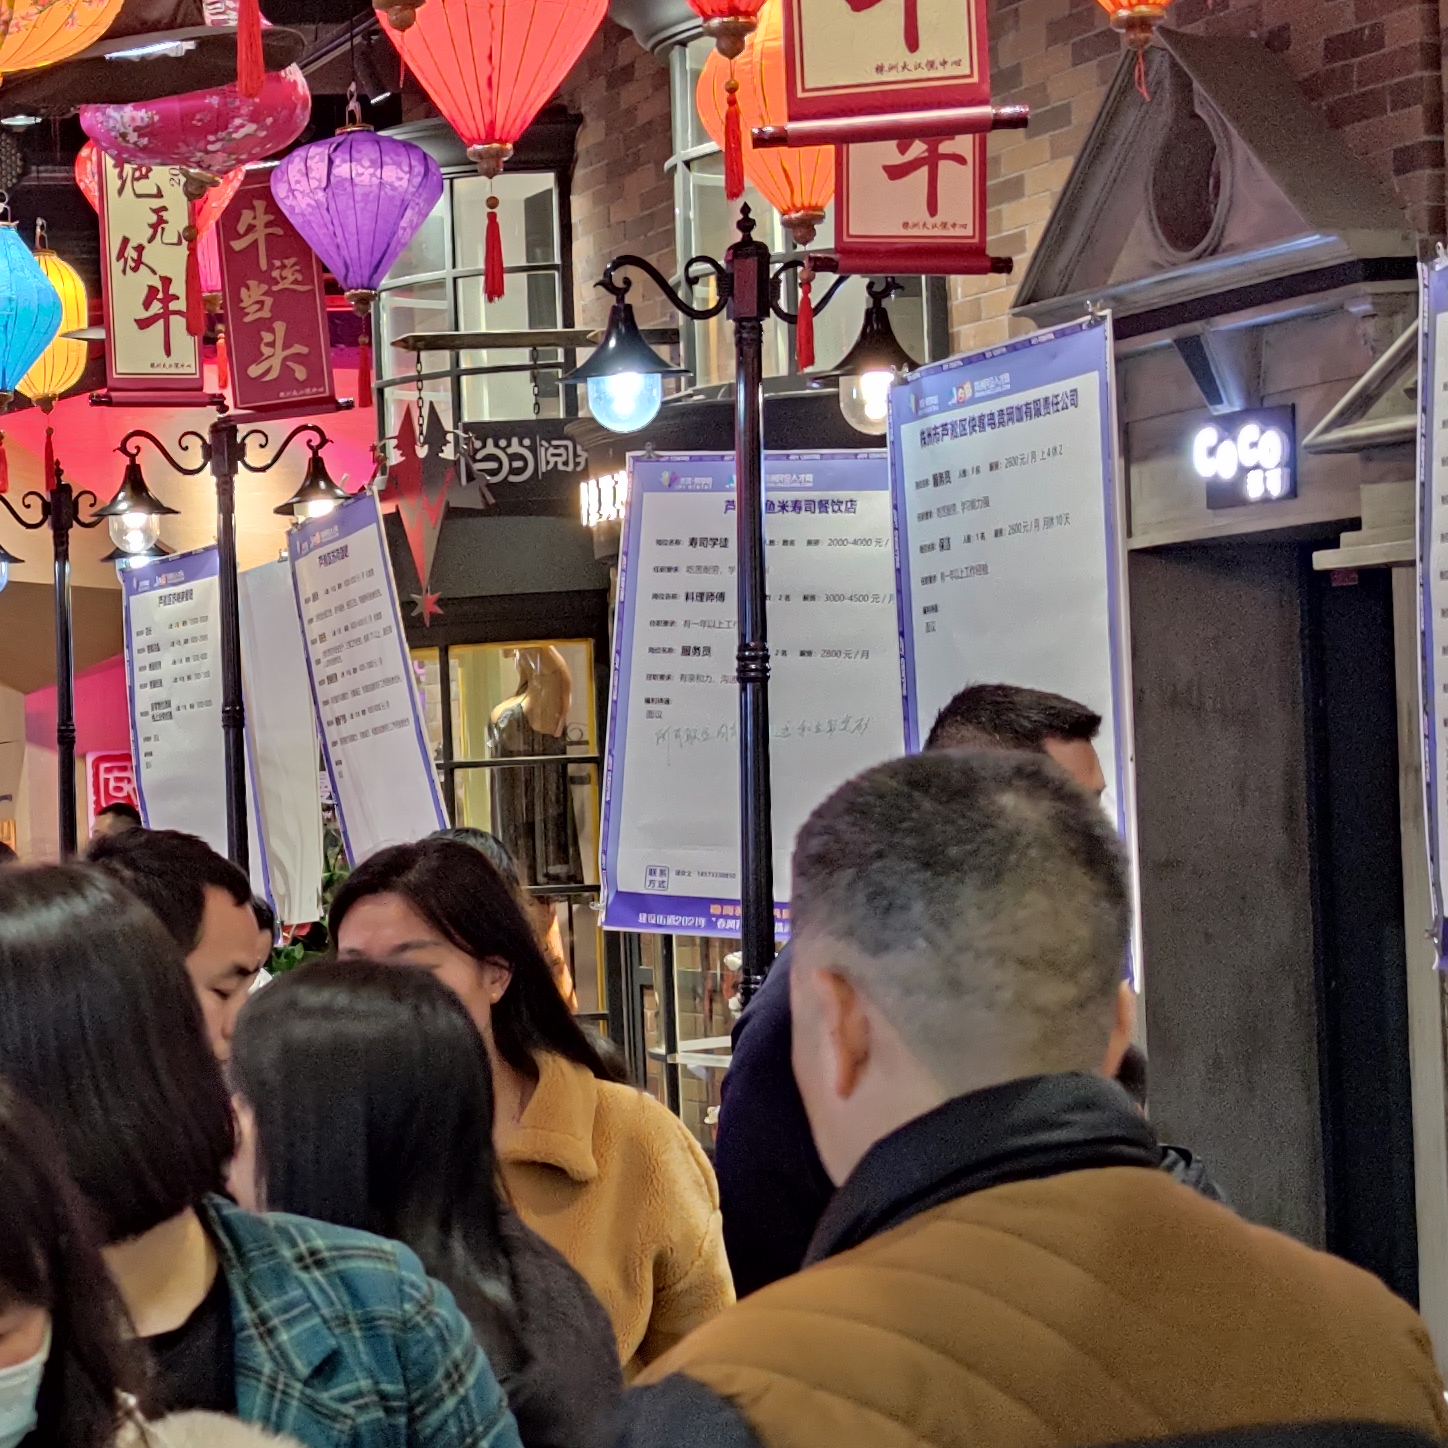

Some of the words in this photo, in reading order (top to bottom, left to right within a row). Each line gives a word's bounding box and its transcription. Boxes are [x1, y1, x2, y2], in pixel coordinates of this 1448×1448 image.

[229, 199, 314, 383] 牛运当头
[723, 499, 858, 515] 芦鱼米寿司餐饮店
